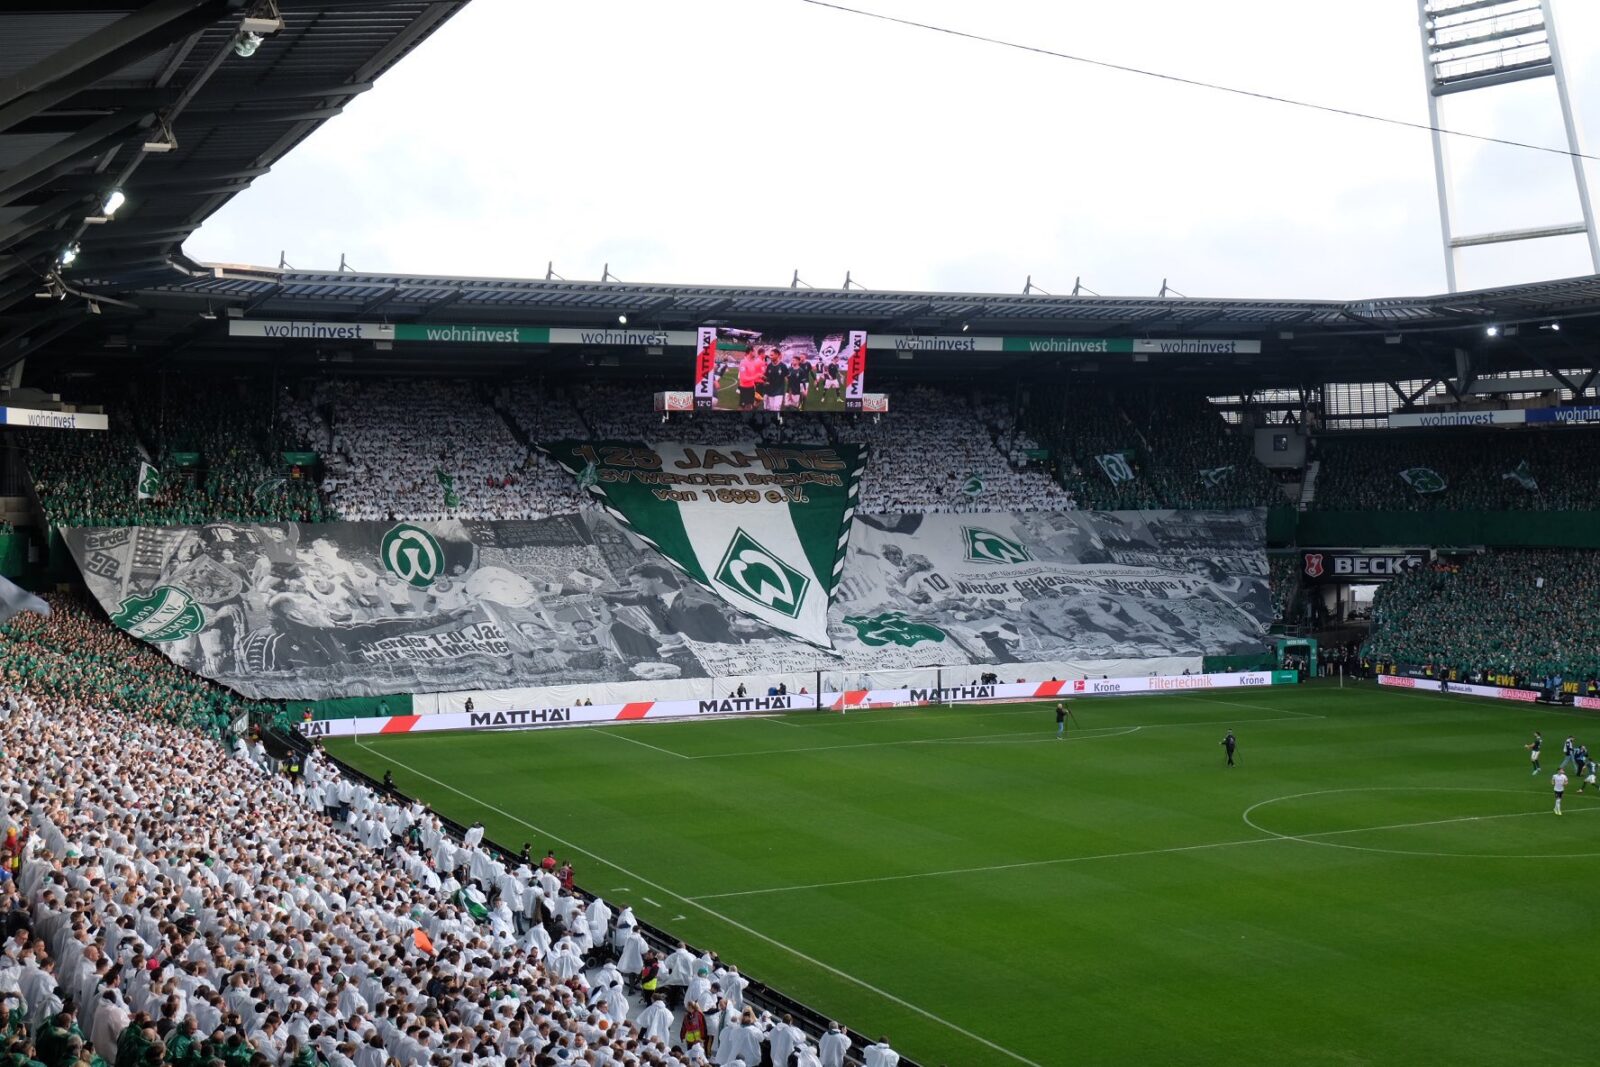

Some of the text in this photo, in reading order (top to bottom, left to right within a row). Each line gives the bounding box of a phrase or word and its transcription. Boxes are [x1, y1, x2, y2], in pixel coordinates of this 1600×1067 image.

[264, 321, 362, 338] wohninvest
[426, 325, 520, 343] wohninvest
[581, 330, 669, 345] wohninvest
[895, 335, 976, 351] wohninvest
[1029, 337, 1108, 353] wohninvest
[1160, 339, 1237, 353] wohninvest
[27, 411, 76, 428] wohninvest
[1419, 411, 1494, 426] wohninvest
[571, 444, 847, 470] 125 JAHRE
[631, 470, 744, 486] WERDER
[744, 471, 844, 487] BREMEN
[651, 486, 810, 504] von 1899 e.V.
[956, 580, 1010, 595] Werder
[126, 605, 155, 624] 1899
[360, 634, 429, 652] Werder
[1093, 682, 1121, 692] Krone
[1148, 676, 1213, 690] Filtertechnik
[1239, 675, 1265, 685] Krone
[1495, 674, 1516, 687] EWE
[910, 685, 995, 702] MATTHÄI
[699, 695, 791, 713] MATTHÄI
[470, 708, 570, 726] MATTHÄI
